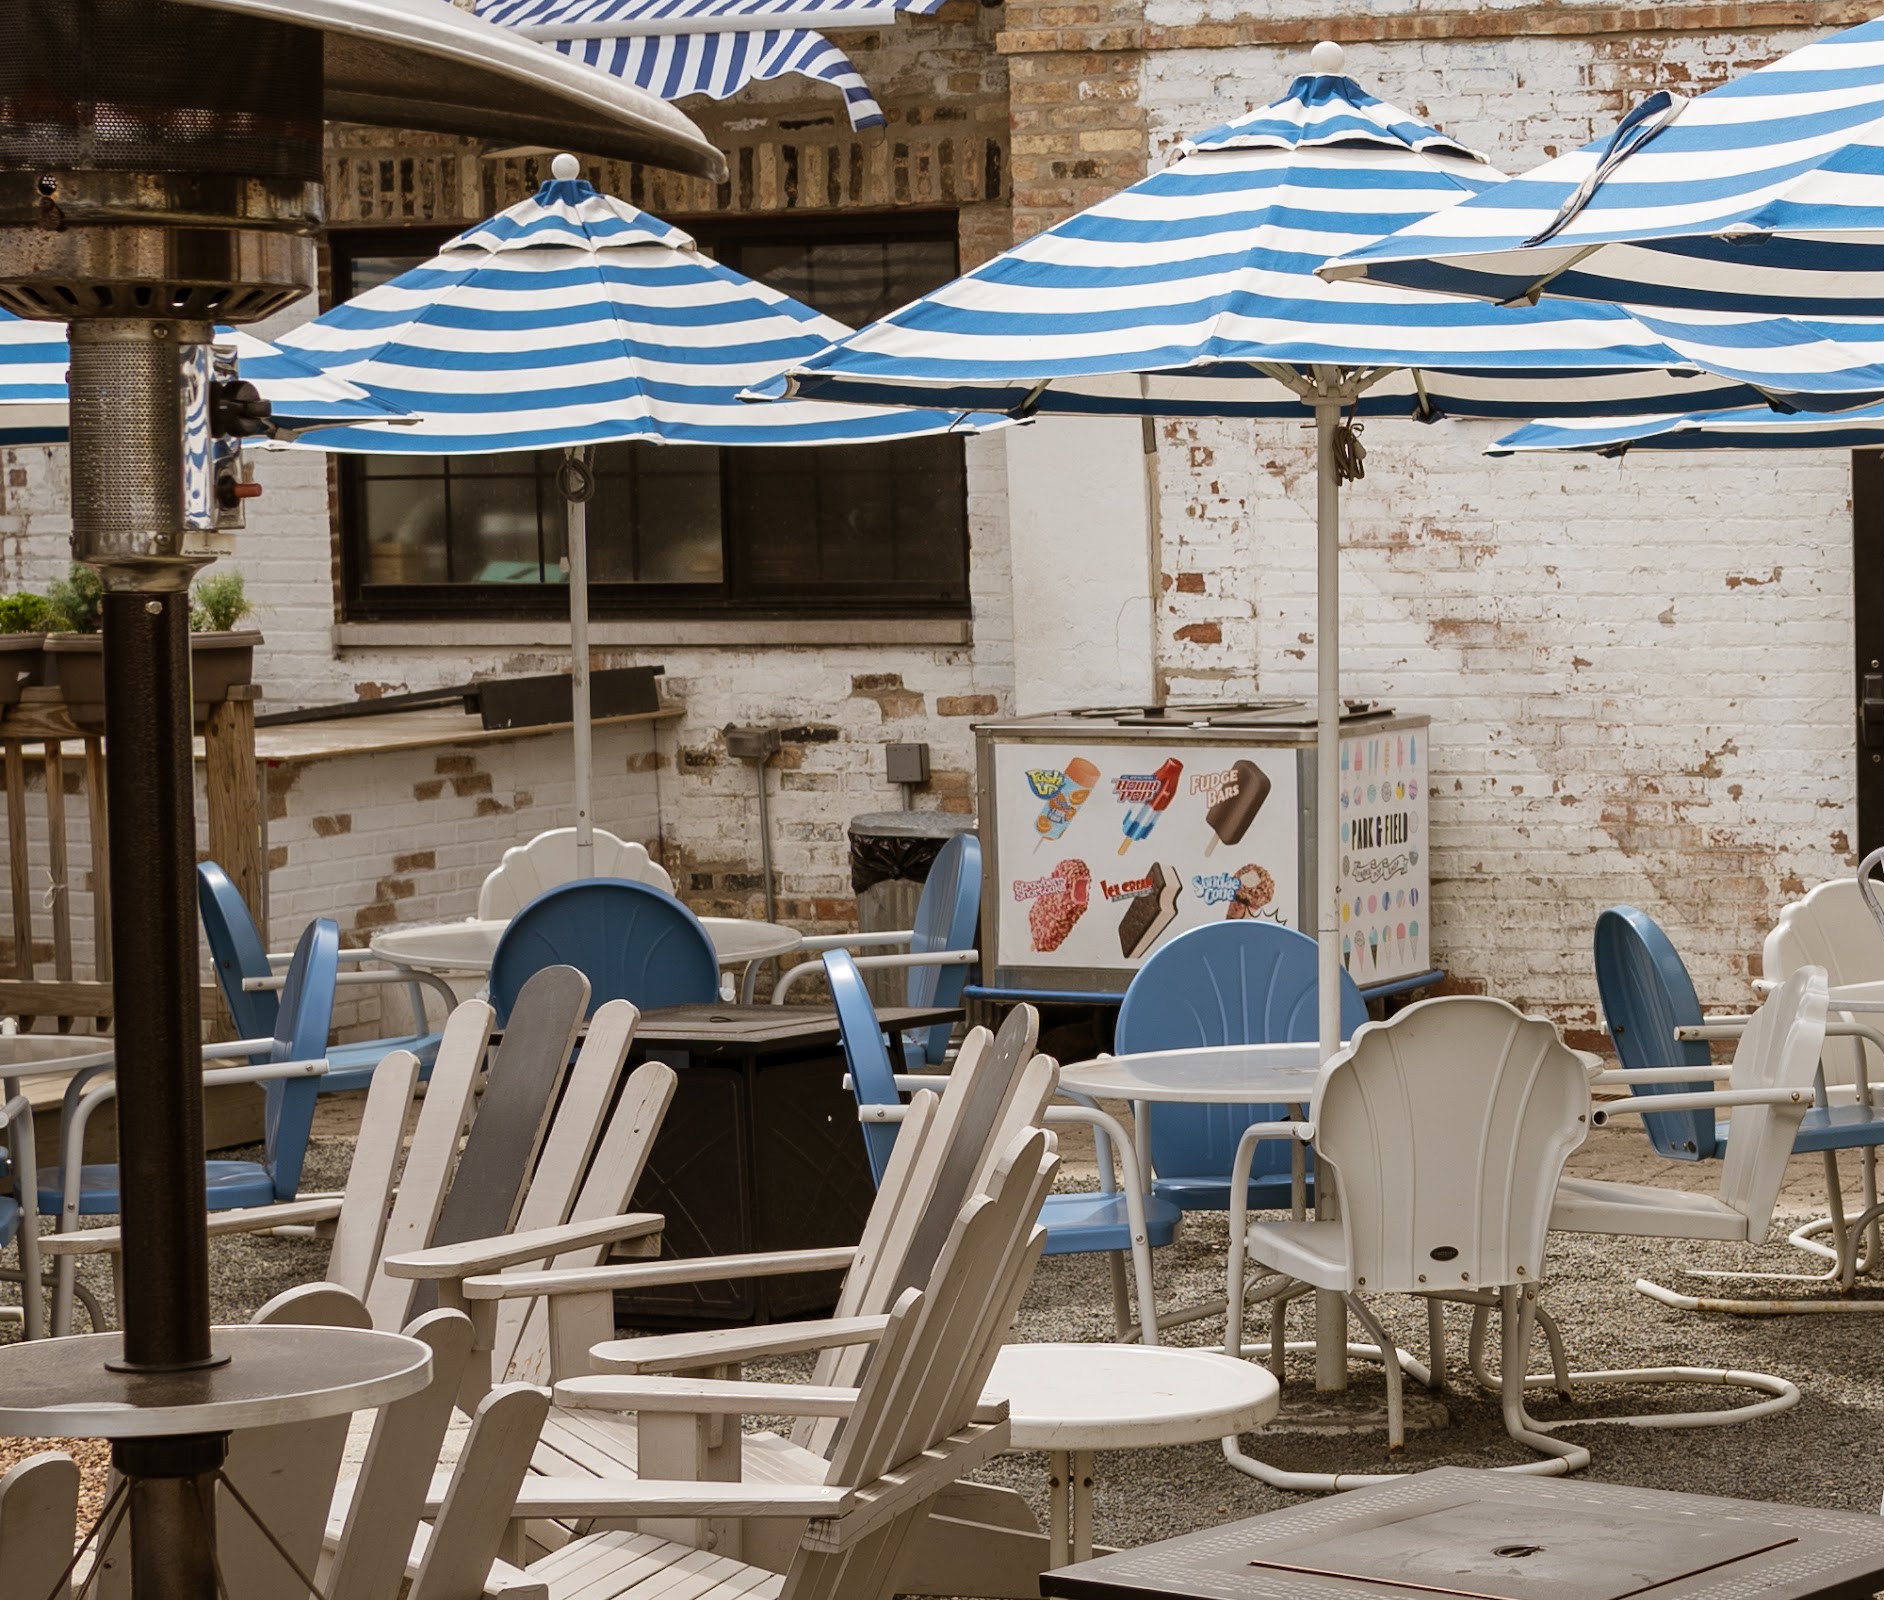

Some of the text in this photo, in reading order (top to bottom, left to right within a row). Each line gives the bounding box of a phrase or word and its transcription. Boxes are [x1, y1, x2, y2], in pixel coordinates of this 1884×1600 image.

[1190, 770, 1239, 795] FUDGE
[1119, 791, 1153, 801] POP
[1207, 784, 1240, 808] BARS
[1352, 816, 1373, 851] PARK
[1385, 812, 1408, 846] FIELD
[1122, 877, 1153, 892] CREAM
[1192, 872, 1241, 897] Sundae
